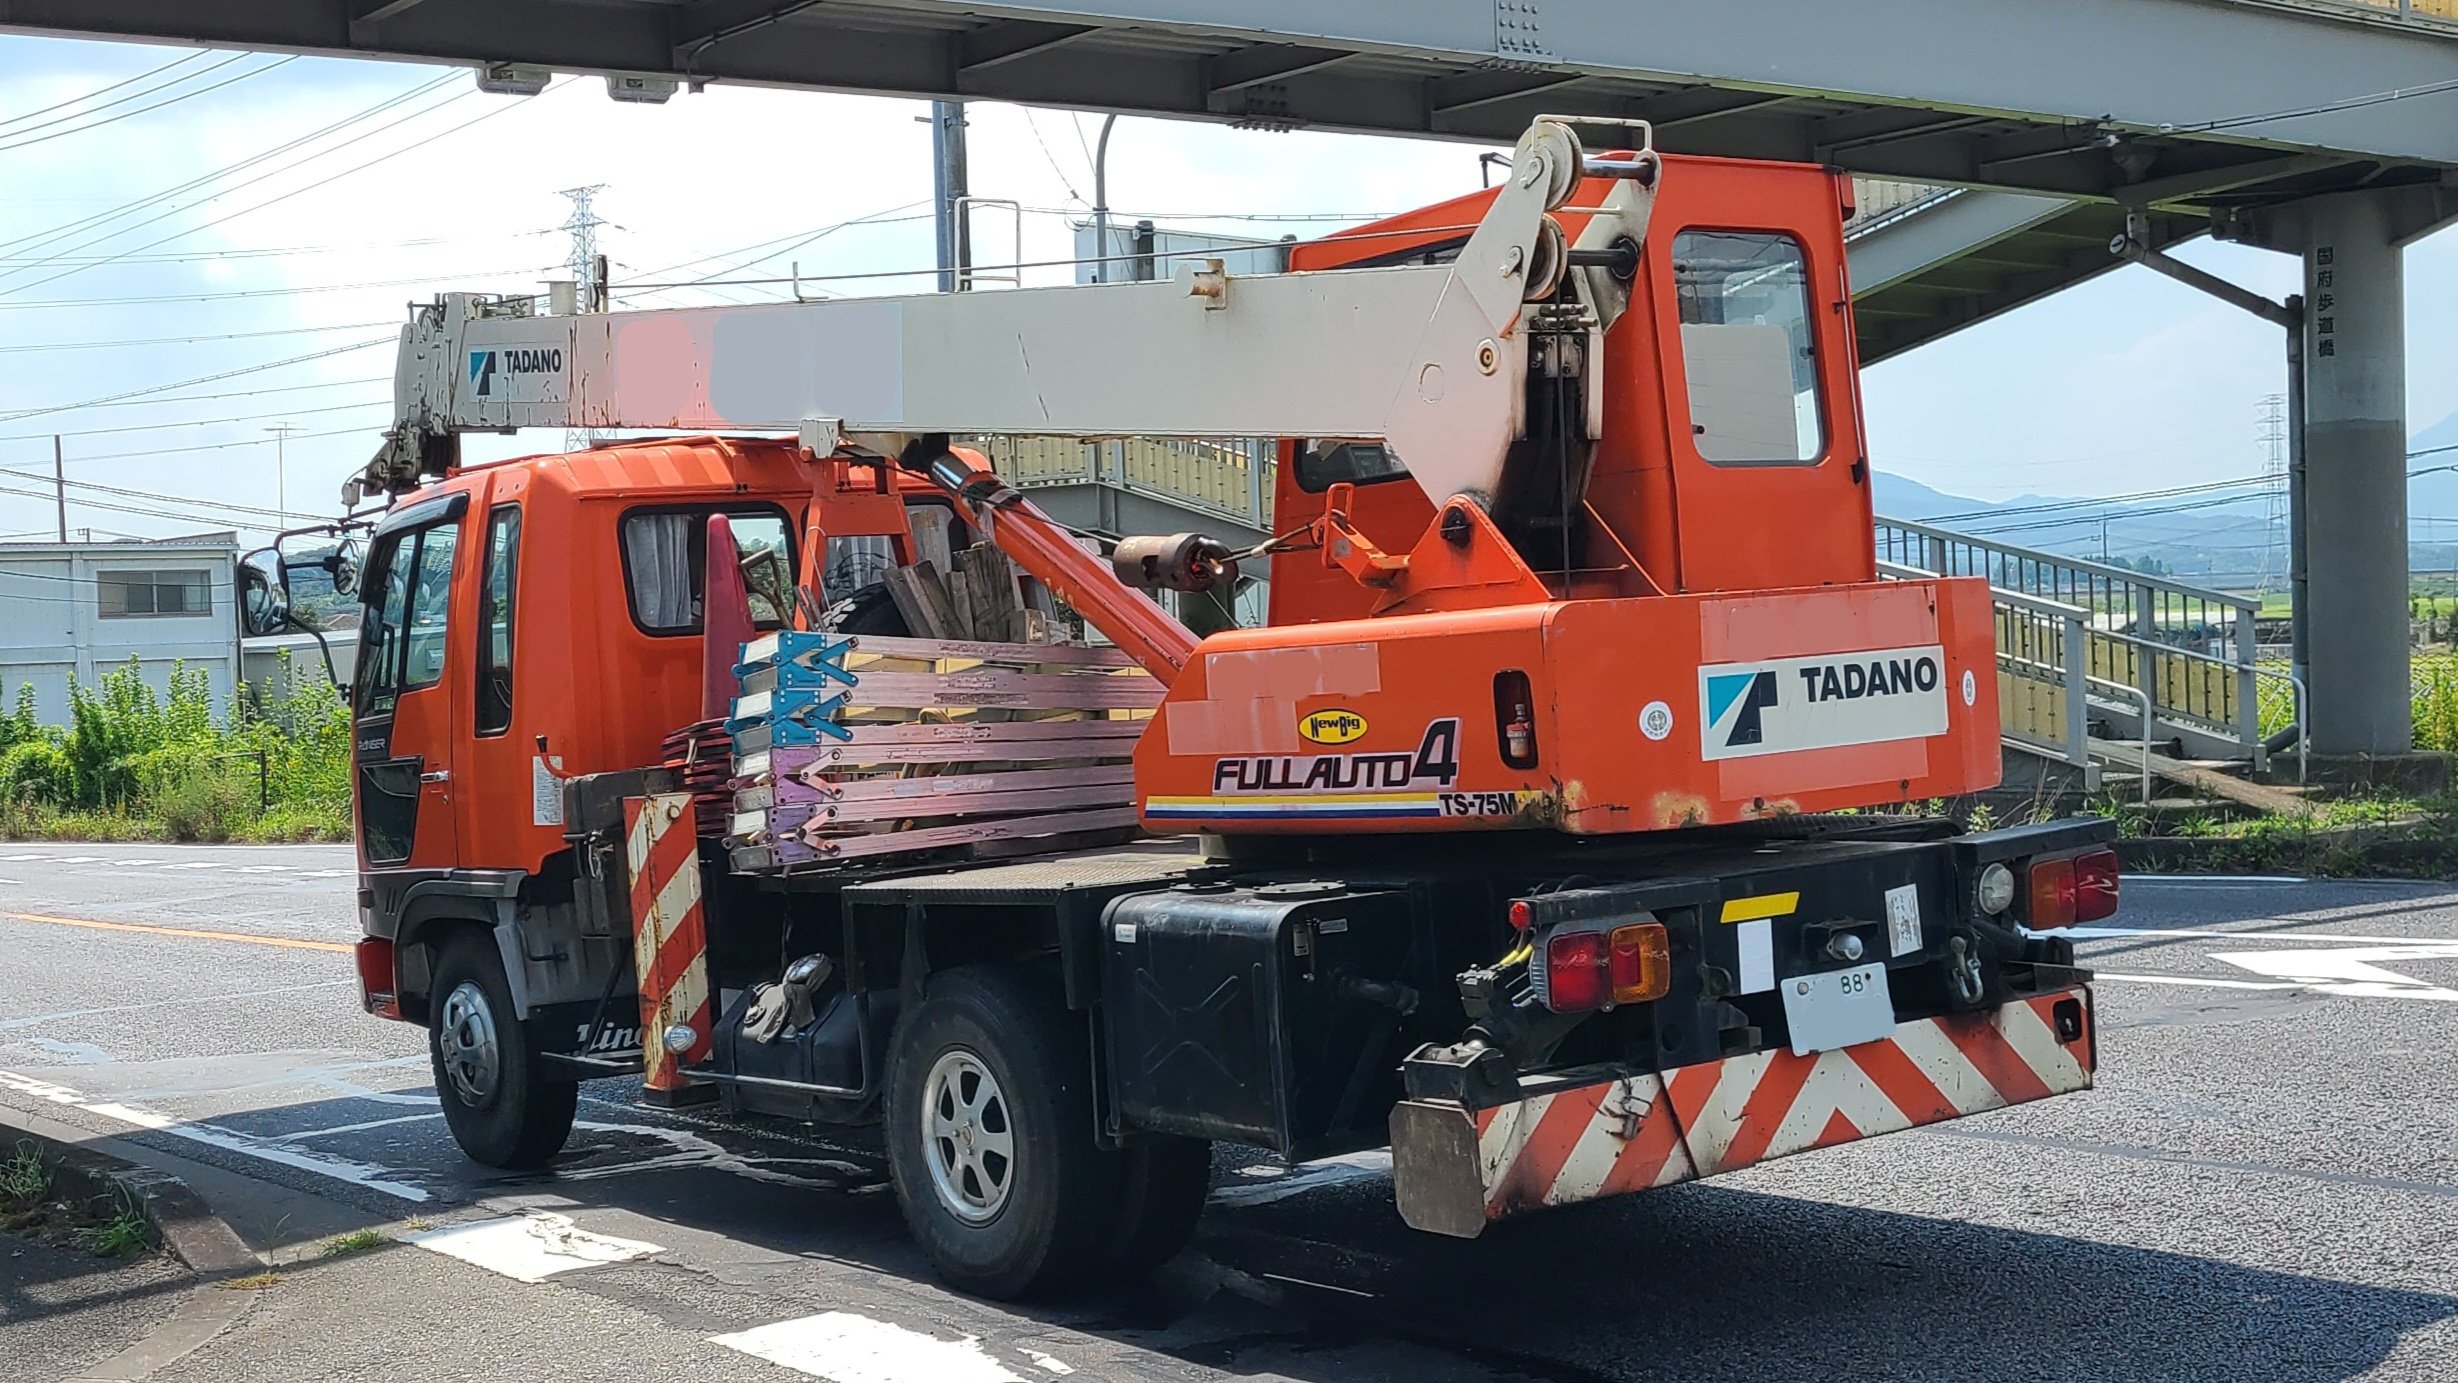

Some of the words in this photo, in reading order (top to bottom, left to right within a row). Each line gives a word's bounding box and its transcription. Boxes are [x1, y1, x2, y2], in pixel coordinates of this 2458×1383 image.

[2316, 246, 2335, 358] 国府歩道橋
[504, 348, 562, 374] TADANO
[1800, 656, 1938, 703] TADANO
[1438, 792, 1516, 816] TS-75M
[1840, 973, 1864, 995] 88
